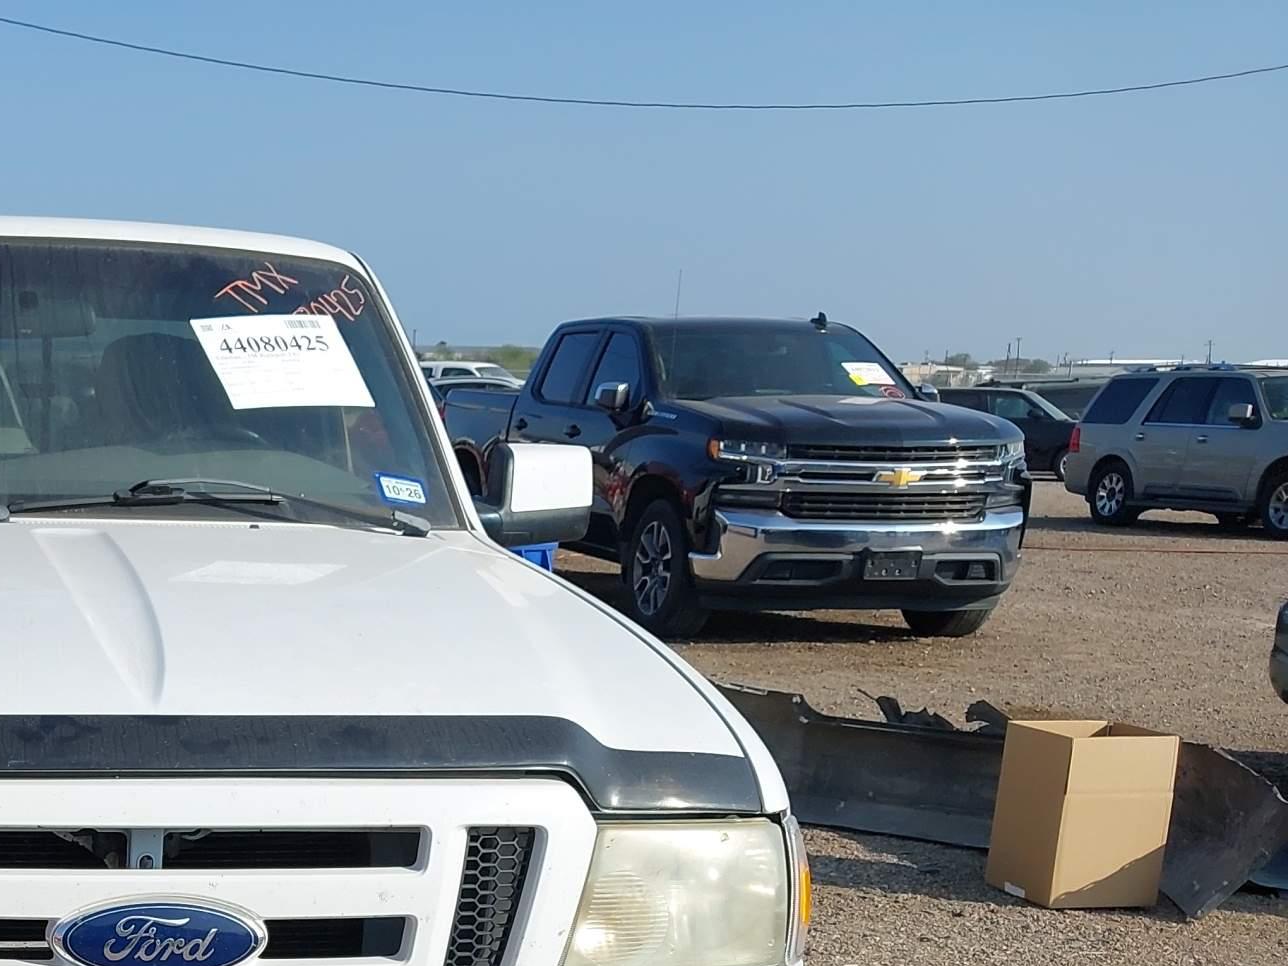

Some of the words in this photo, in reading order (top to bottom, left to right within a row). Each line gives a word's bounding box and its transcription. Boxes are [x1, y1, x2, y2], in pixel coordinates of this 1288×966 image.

[214, 262, 299, 313] TMX
[219, 335, 330, 354] 44080425
[103, 915, 220, 962] Ford
